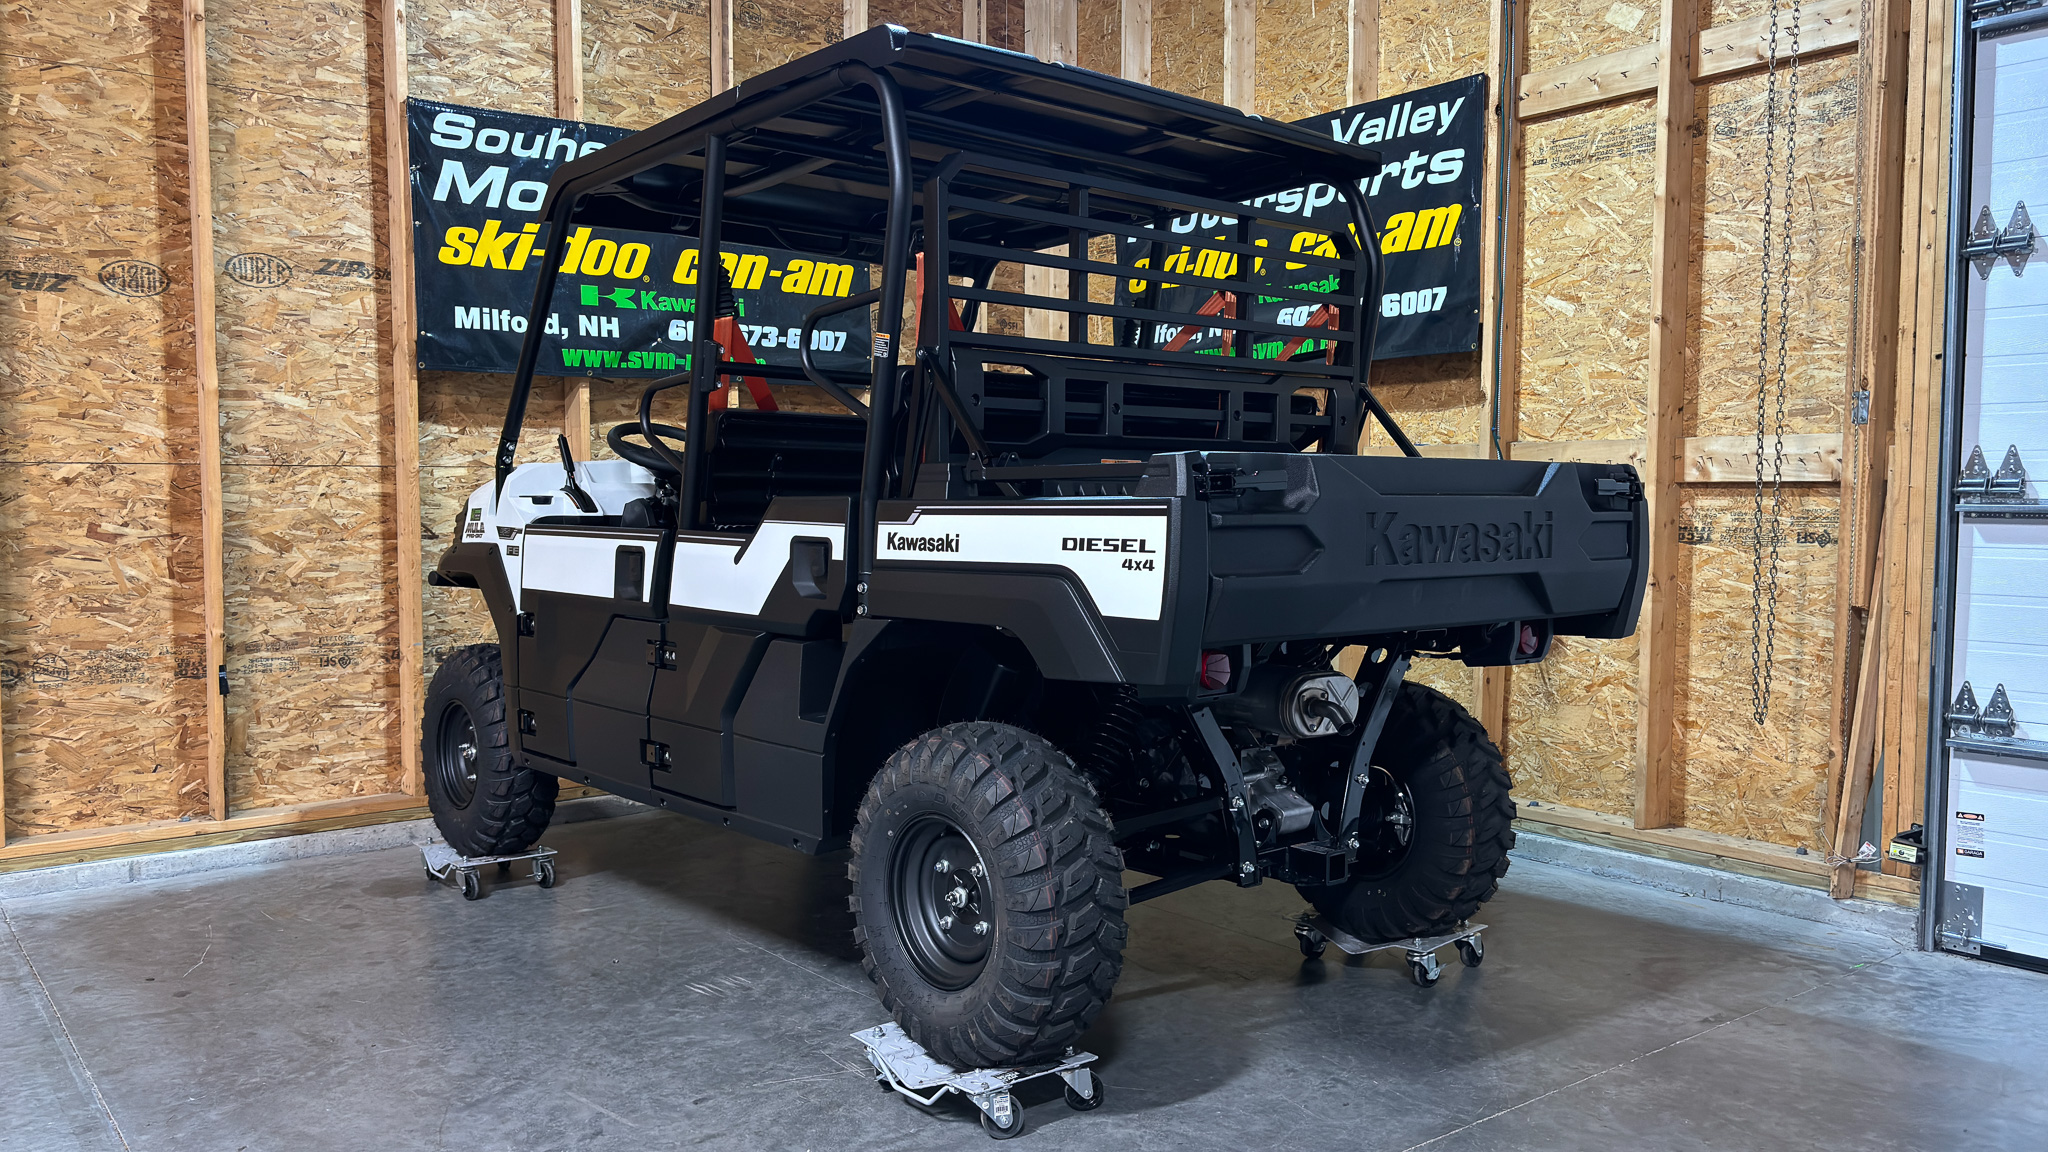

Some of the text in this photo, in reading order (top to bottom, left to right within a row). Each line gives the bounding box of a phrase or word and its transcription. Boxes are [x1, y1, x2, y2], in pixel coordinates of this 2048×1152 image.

[1331, 97, 1466, 145] Valley
[455, 306, 569, 340] Milfod,
[579, 315, 620, 338] NH
[886, 531, 1156, 553] Kawasaki DIESEL
[1365, 510, 1554, 567] Kawasaki
[1121, 558, 1155, 572] 4x4
